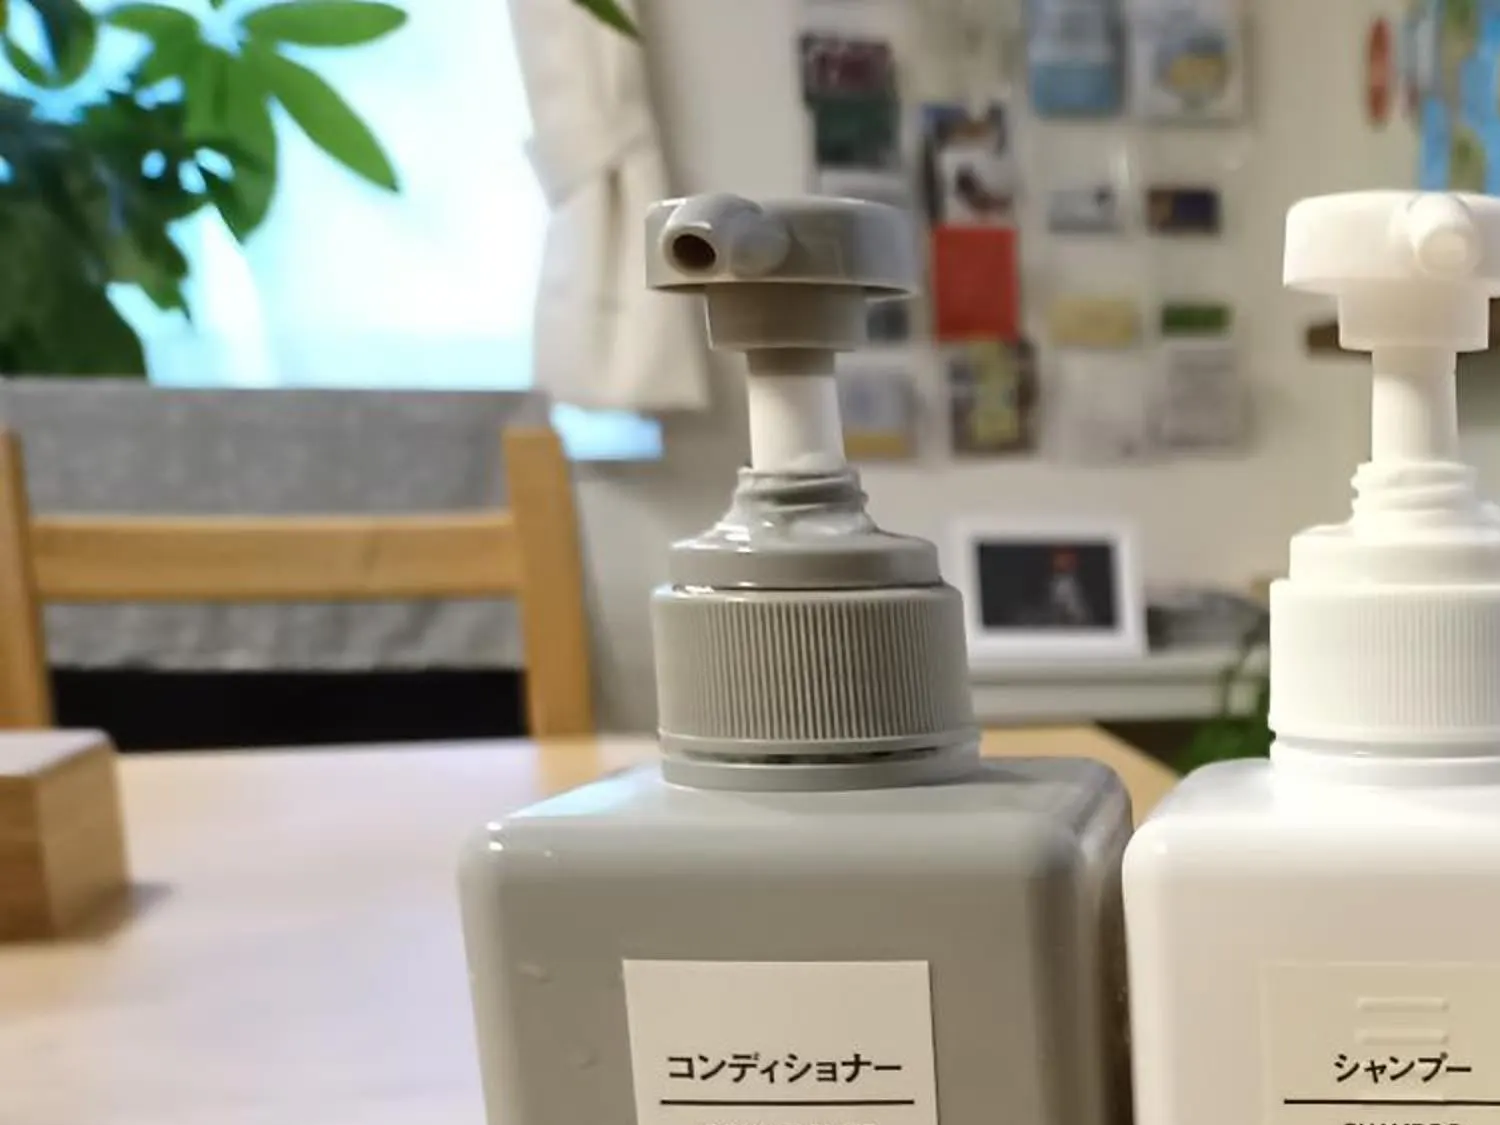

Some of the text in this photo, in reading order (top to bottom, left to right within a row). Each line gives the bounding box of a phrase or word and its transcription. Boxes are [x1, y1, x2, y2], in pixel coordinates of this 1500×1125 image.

[667, 1052, 903, 1085] コンディショナー
[1333, 1051, 1473, 1084] シャンプー
